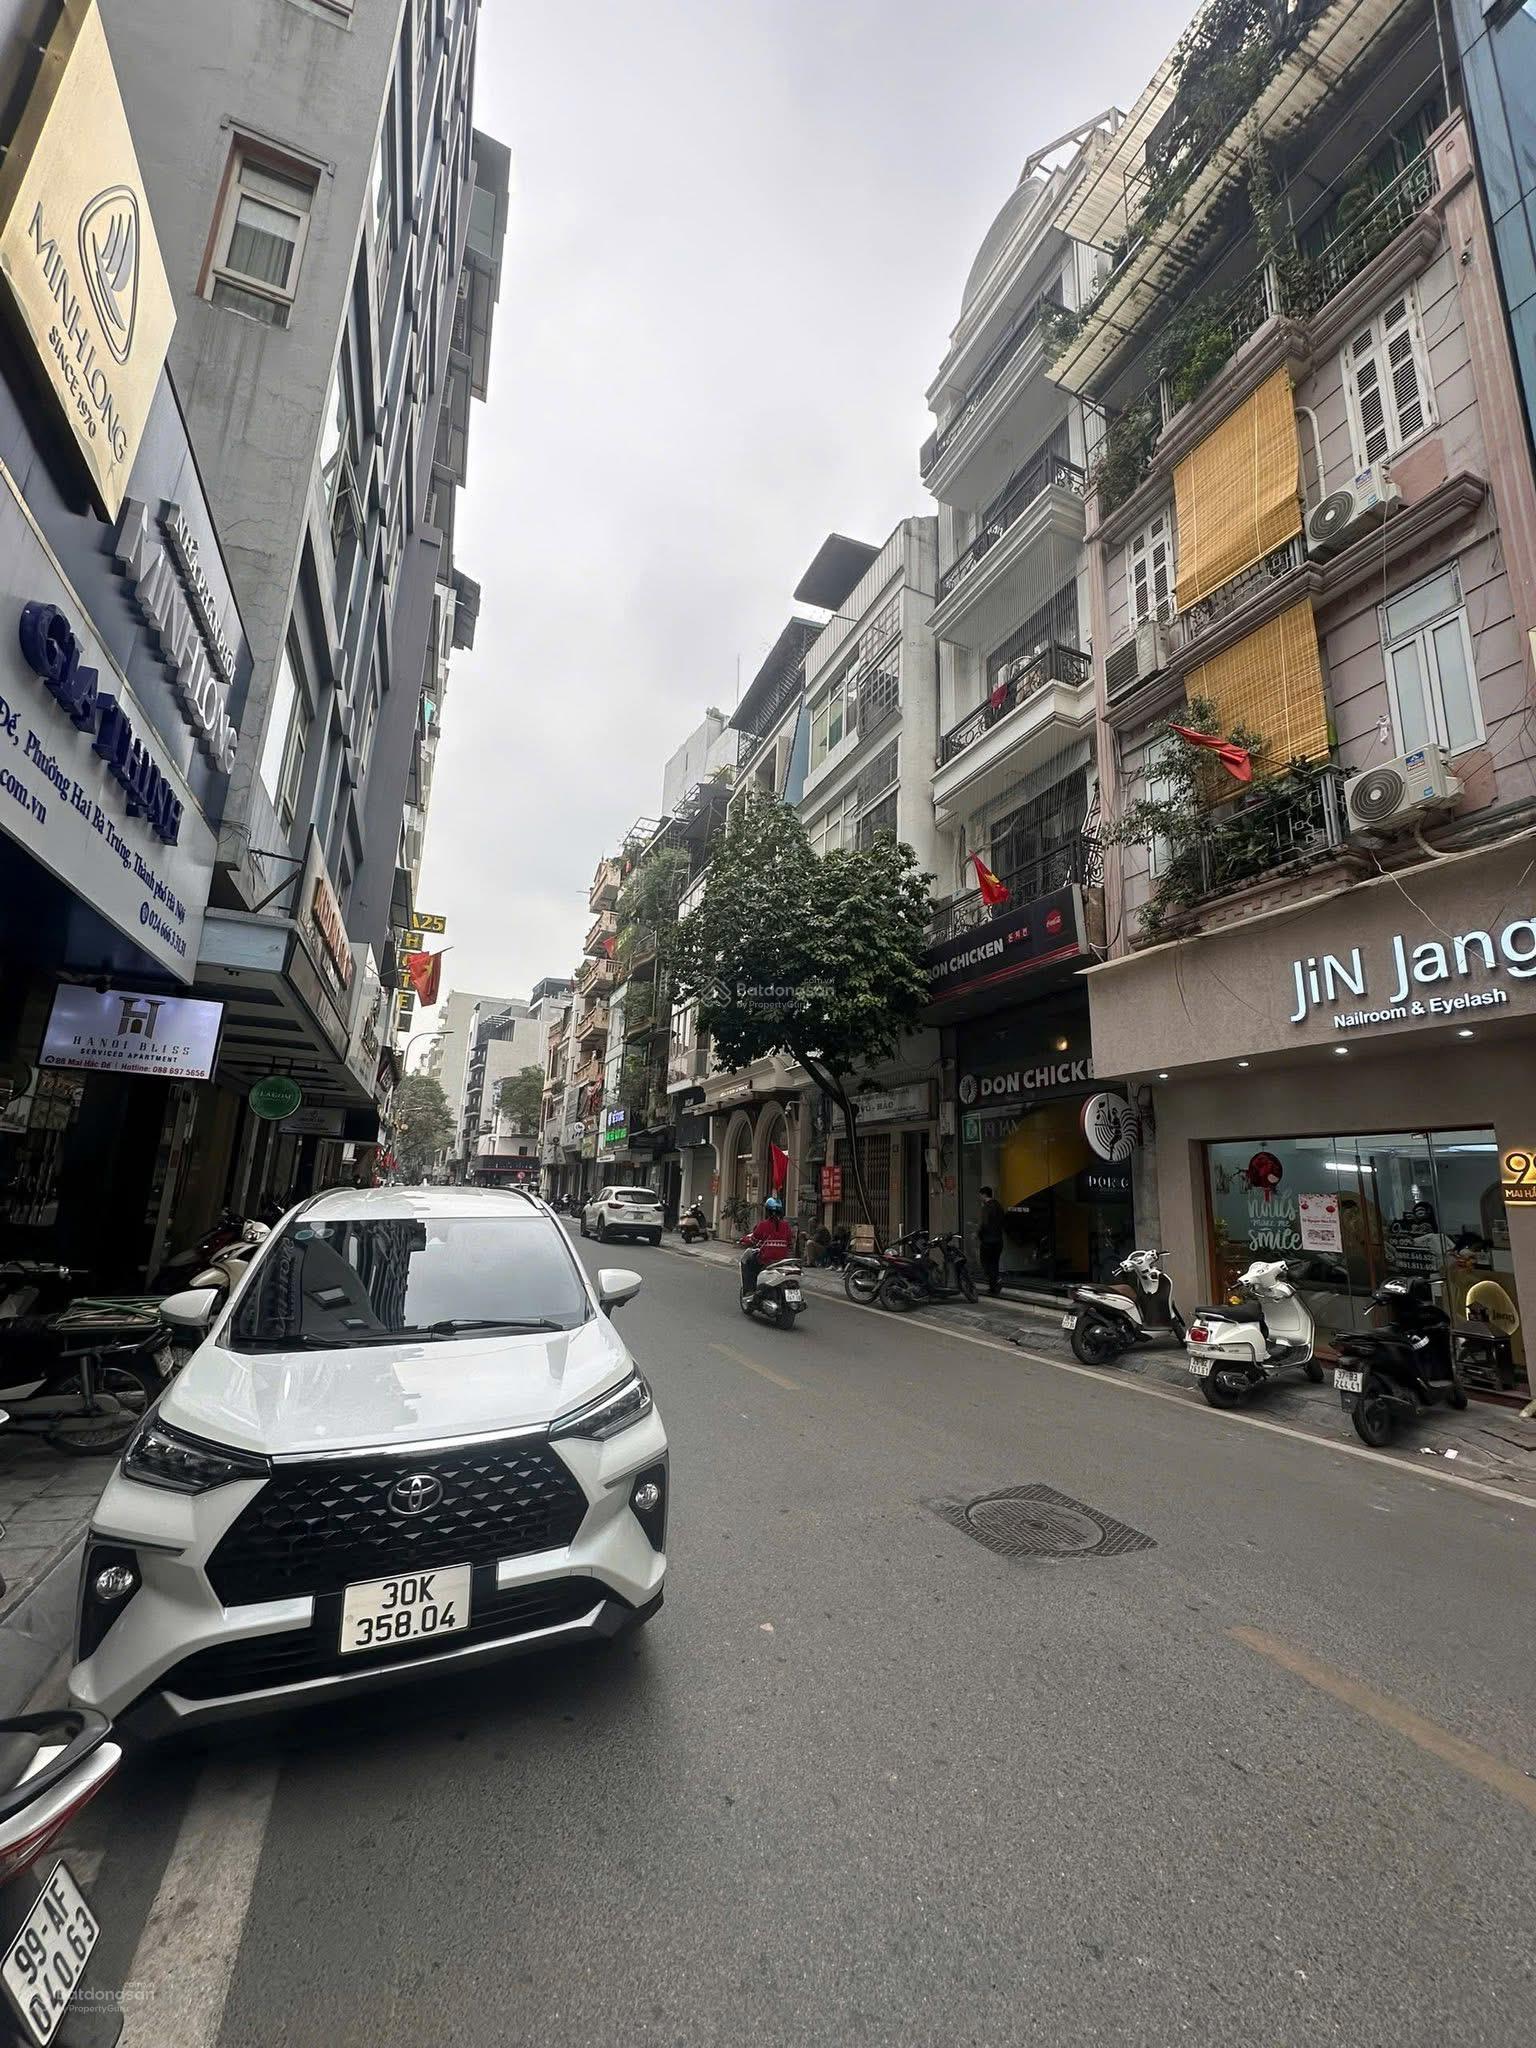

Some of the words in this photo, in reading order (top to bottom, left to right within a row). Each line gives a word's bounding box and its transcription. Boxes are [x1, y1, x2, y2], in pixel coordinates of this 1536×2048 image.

[28, 200, 88, 364] MINH
[83, 345, 128, 464] LONG
[48, 325, 78, 397] SINCE
[77, 391, 97, 439] 1970
[182, 653, 239, 776] LONG
[23, 729, 71, 801] Phường
[70, 782, 91, 820] Hai
[92, 805, 105, 835] Bà
[950, 938, 1004, 973] CHICKEN
[1290, 946, 1367, 1023] JiN
[1390, 917, 1536, 1003] Jang
[1333, 1005, 1407, 1029] Nailroom
[1410, 1001, 1426, 1016] &
[1429, 988, 1508, 1014] Eyelash
[73, 1035, 129, 1049] HANOI
[139, 1042, 191, 1056] BLISS
[80, 1047, 124, 1058] SERVICED
[127, 1052, 178, 1063] APARTMENT
[121, 1063, 151, 1072] Hotline:
[169, 1067, 184, 1076] 697
[980, 1070, 1021, 1096] DON
[1506, 1153, 1536, 1184] 9
[1505, 1189, 1523, 1198] MAI
[1248, 1227, 1304, 1252] smile
[382, 1574, 436, 1610] 30K
[355, 1601, 456, 1646] 358.04
[14, 1878, 69, 1985] 99-AF
[29, 1906, 96, 2036] 040.63
